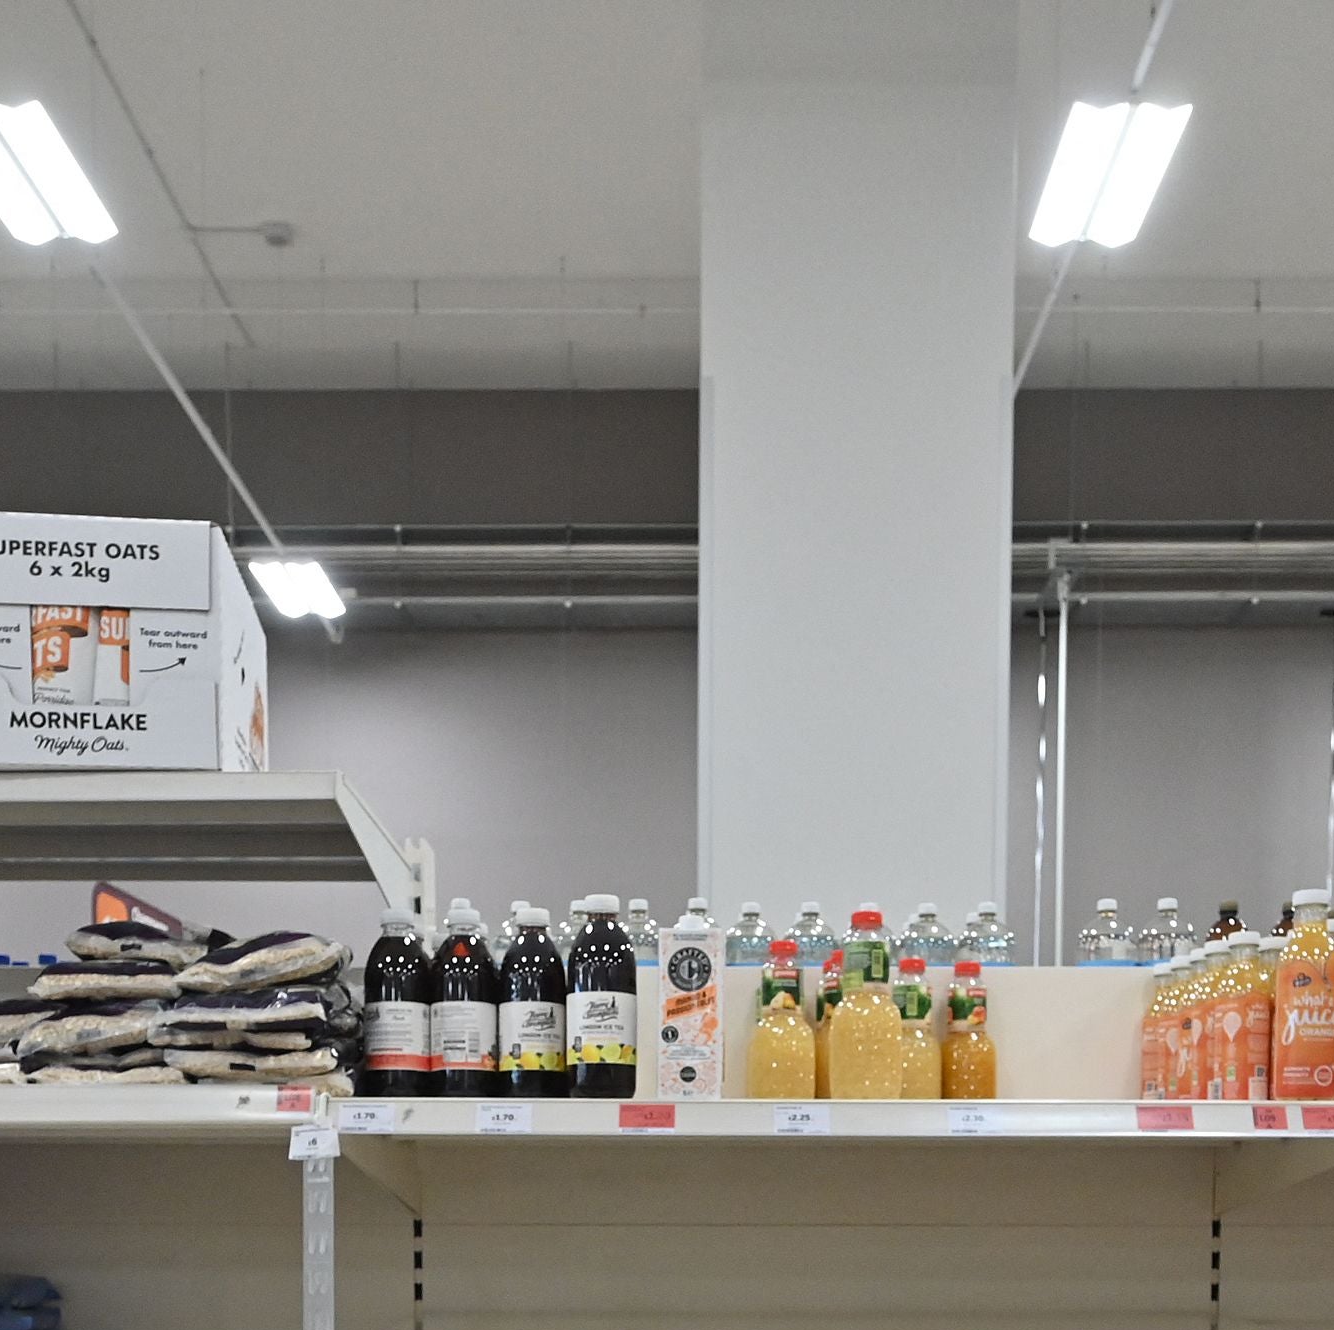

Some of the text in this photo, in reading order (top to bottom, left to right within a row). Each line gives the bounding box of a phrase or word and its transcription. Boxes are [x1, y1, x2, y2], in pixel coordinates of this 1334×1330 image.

[104, 543, 161, 561] OATS
[28, 560, 111, 582] 6 x 2kg
[9, 711, 148, 731] MORNFLAKE
[33, 735, 88, 757] Mighty
